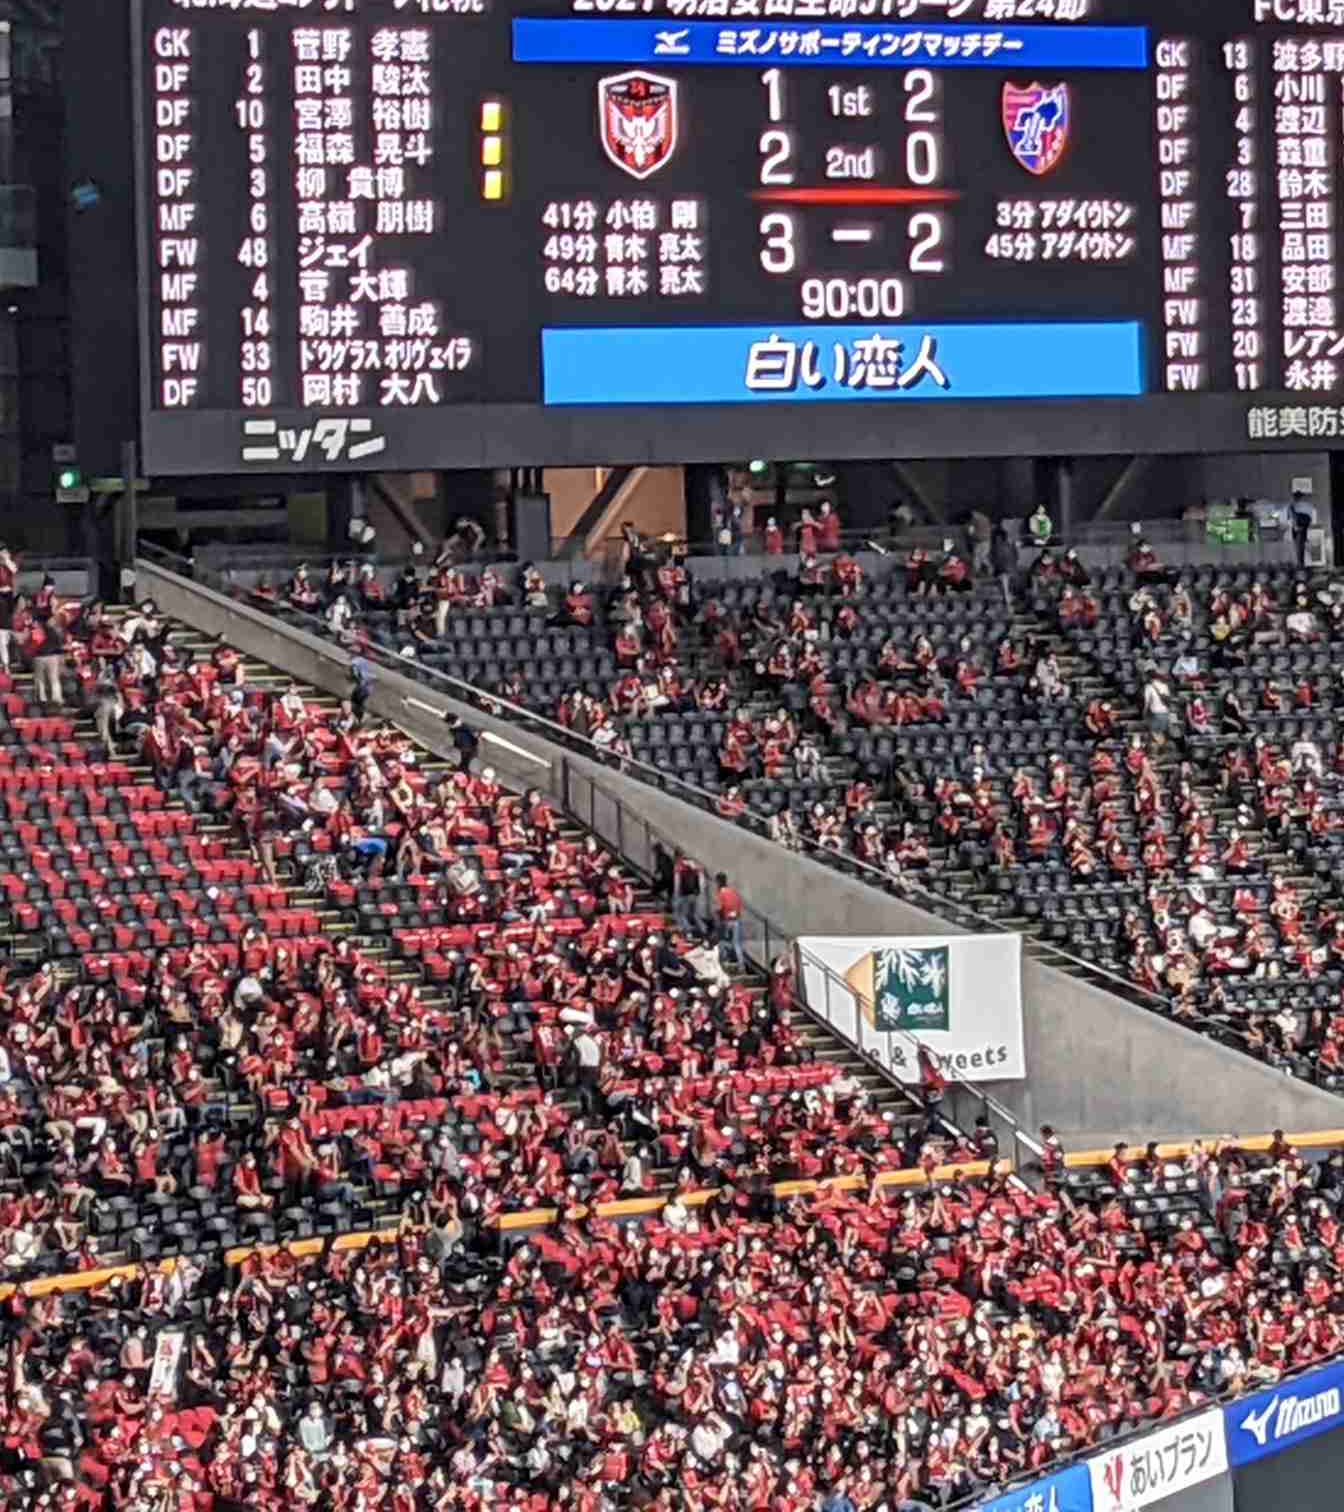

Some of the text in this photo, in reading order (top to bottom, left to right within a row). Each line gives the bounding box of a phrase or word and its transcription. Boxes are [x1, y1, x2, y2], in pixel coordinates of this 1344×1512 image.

[156, 28, 190, 58] GK
[248, 29, 259, 59] 1
[293, 29, 351, 61] 菅野
[716, 30, 1024, 58] ミズノサポーティングマッチデー
[1156, 42, 1188, 68] GK
[1223, 41, 1248, 69] 13
[156, 65, 190, 92] DF
[248, 64, 263, 93] 2
[295, 65, 351, 94] 田中
[1157, 74, 1187, 100] DF
[1234, 74, 1249, 101] 6
[1274, 73, 1325, 103] 小川
[761, 69, 936, 122] 1 1st 2
[157, 100, 190, 127] DF
[236, 100, 264, 128] 10
[1157, 106, 1188, 132] DF
[1234, 106, 1250, 133] 4
[157, 135, 191, 162] DF
[250, 135, 265, 163] 5
[760, 131, 937, 185] 2 2nd 0
[1159, 138, 1189, 164] DF
[1237, 138, 1251, 165] 3
[158, 169, 193, 196] DF
[251, 168, 266, 197] 3
[1160, 171, 1189, 197] DF
[1226, 170, 1253, 197] 28
[160, 204, 195, 231] MF
[251, 203, 266, 232] 6
[542, 200, 597, 231] 41分
[996, 198, 1132, 229] 3分 アダイウトン
[1161, 202, 1195, 228] MF
[1239, 202, 1253, 229] 7
[1279, 202, 1330, 230] 三田
[160, 235, 374, 268] FW 48 ジェイ
[544, 233, 598, 262] 49分
[760, 213, 796, 273] 3
[908, 212, 943, 272] 2
[985, 230, 1135, 261] 45分 アダイウトン
[1162, 235, 1196, 261] MF
[1230, 235, 1255, 262] 18
[1281, 234, 1331, 262] 品田
[161, 274, 197, 301] MF
[253, 273, 268, 302] 4
[545, 265, 599, 295] 64分
[1164, 267, 1197, 293] MF
[1230, 266, 1255, 294] 31
[801, 279, 904, 318] 90:00
[1164, 299, 1199, 326] FW
[1231, 298, 1258, 326] 23
[162, 308, 198, 336] MF
[241, 307, 269, 336] 14
[162, 343, 199, 371] FW
[242, 342, 271, 371] 33
[1166, 332, 1199, 358] FW
[1233, 331, 1259, 358] 20
[745, 334, 950, 391] 白い恋人
[1166, 364, 1199, 390] FW
[1235, 363, 1259, 391] 11
[1285, 360, 1338, 390] 永井
[163, 373, 440, 407] DF 50 岡村 大八
[242, 418, 386, 462] ニッタン
[938, 1044, 1009, 1071] weets
[1129, 1429, 1215, 1498] あいプラン
